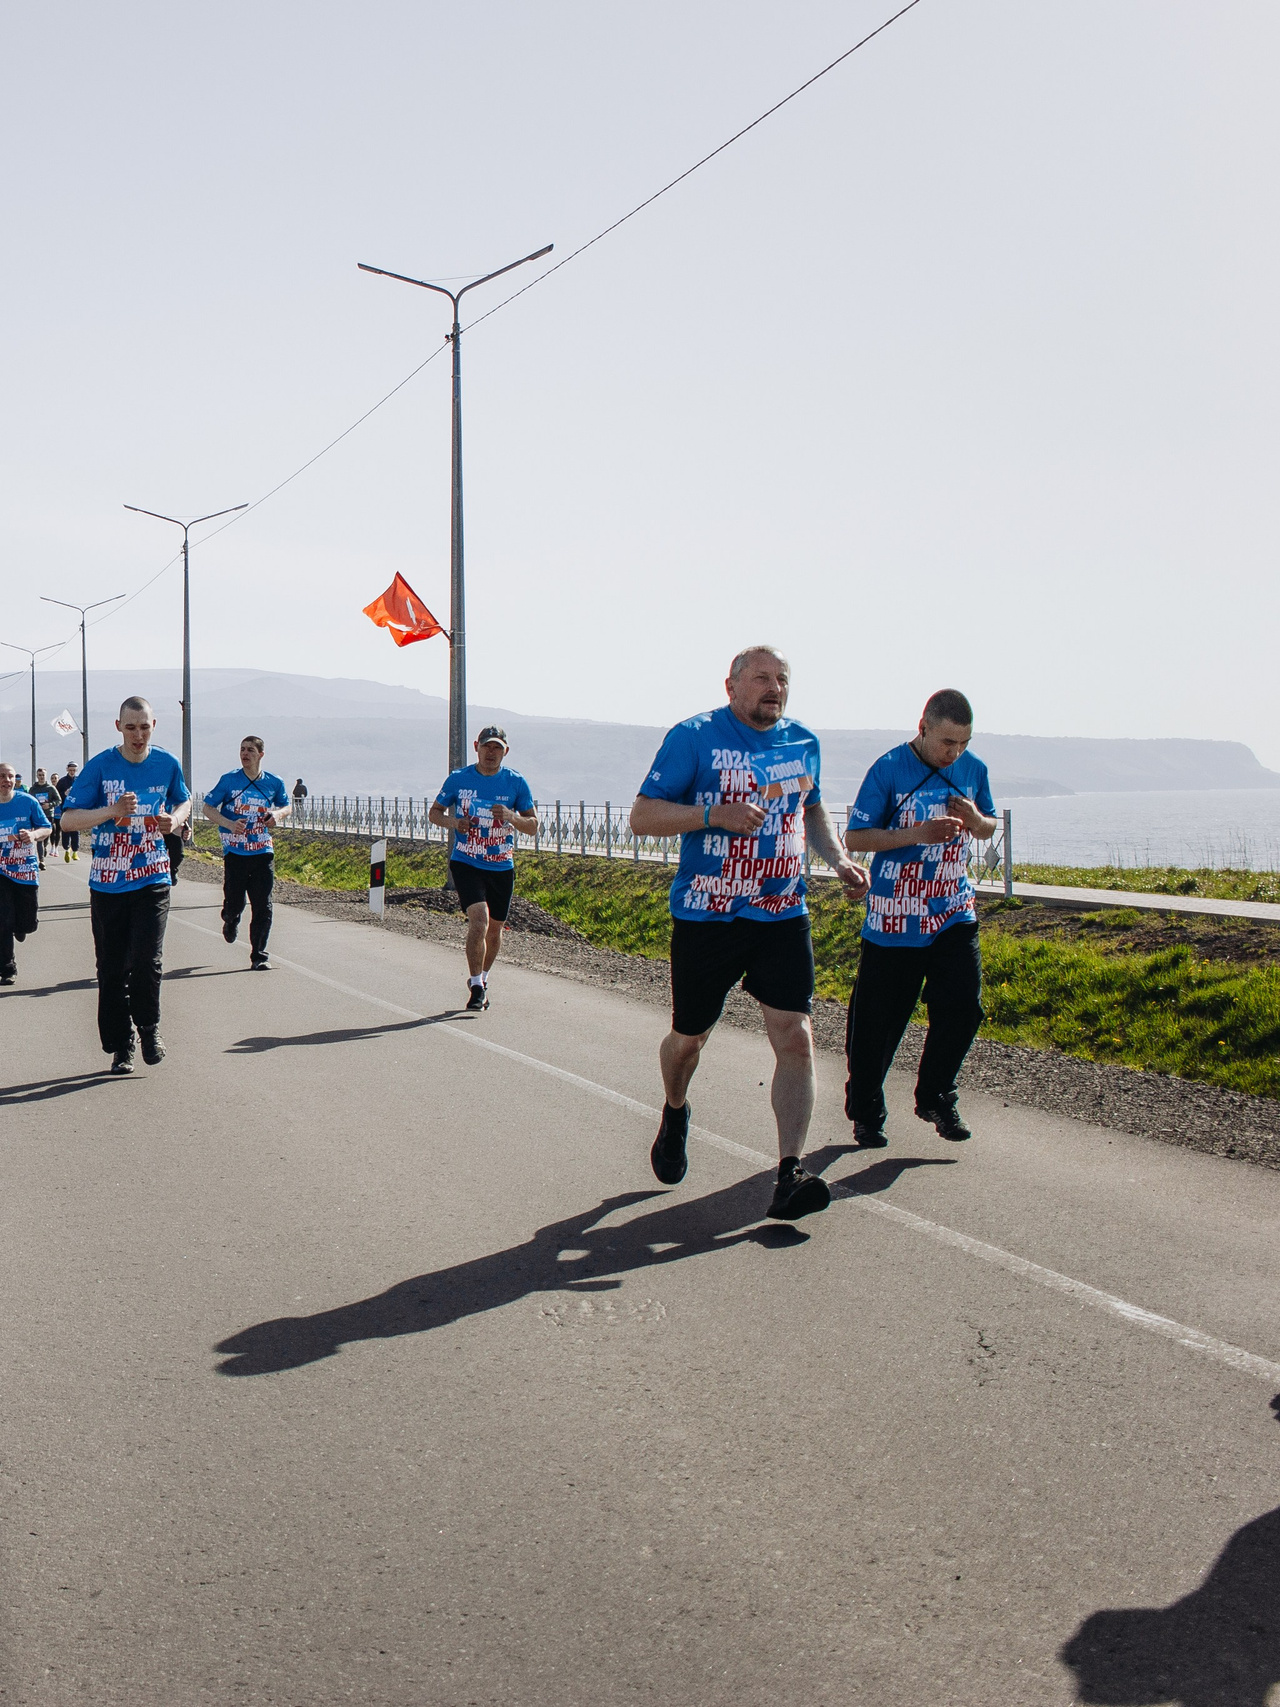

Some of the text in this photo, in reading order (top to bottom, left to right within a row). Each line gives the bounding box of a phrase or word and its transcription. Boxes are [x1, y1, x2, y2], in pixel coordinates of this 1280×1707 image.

[712, 749, 752, 770] 2024
[765, 760, 805, 781] 20008
[102, 780, 125, 793] 2024
[458, 789, 477, 799] 2024
[703, 834, 759, 859] #ЗАБЕГ
[722, 857, 801, 880] #ГОРДОСТЬ
[893, 879, 959, 899] #ГОРДОСТЬ
